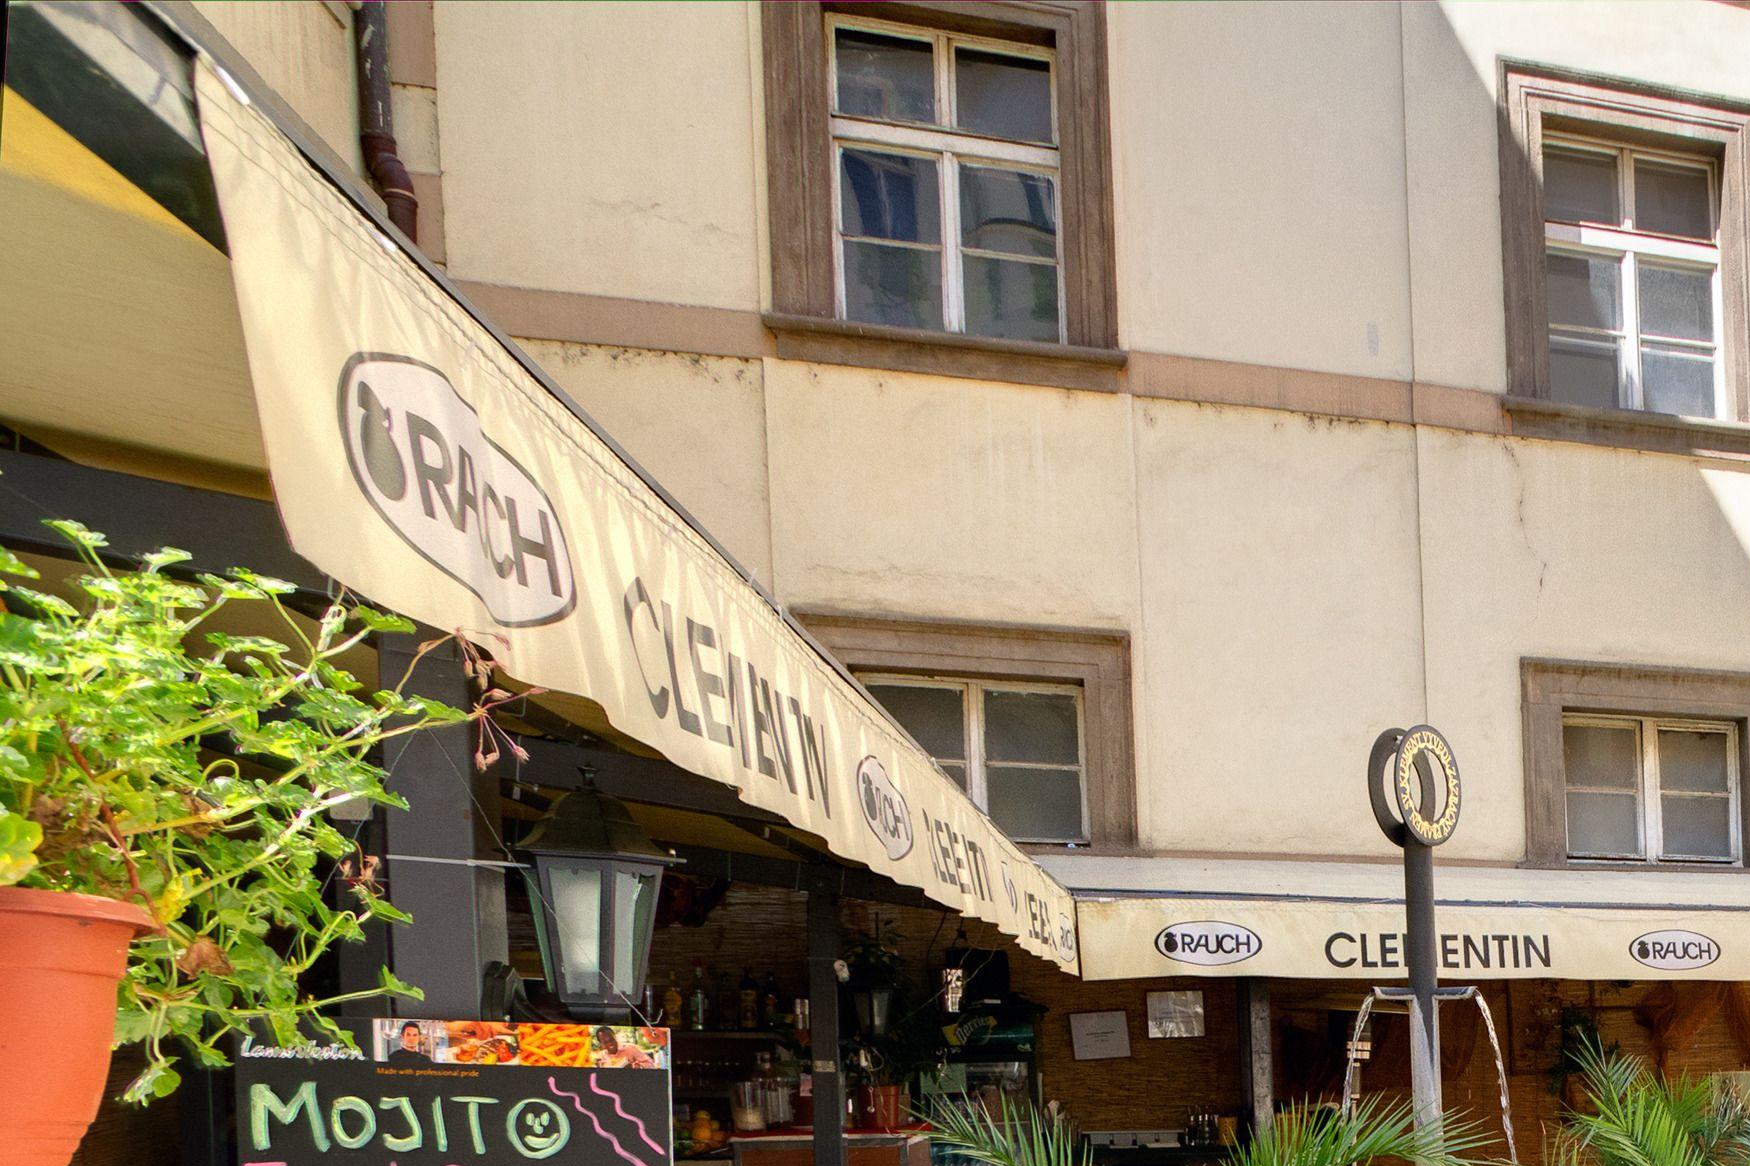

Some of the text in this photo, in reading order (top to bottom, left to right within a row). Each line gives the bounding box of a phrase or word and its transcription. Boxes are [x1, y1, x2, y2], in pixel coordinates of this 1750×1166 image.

[1181, 932, 1250, 954] RAUCH
[1324, 931, 1551, 969] CLEENTIN
[1652, 941, 1713, 961] RAUCH
